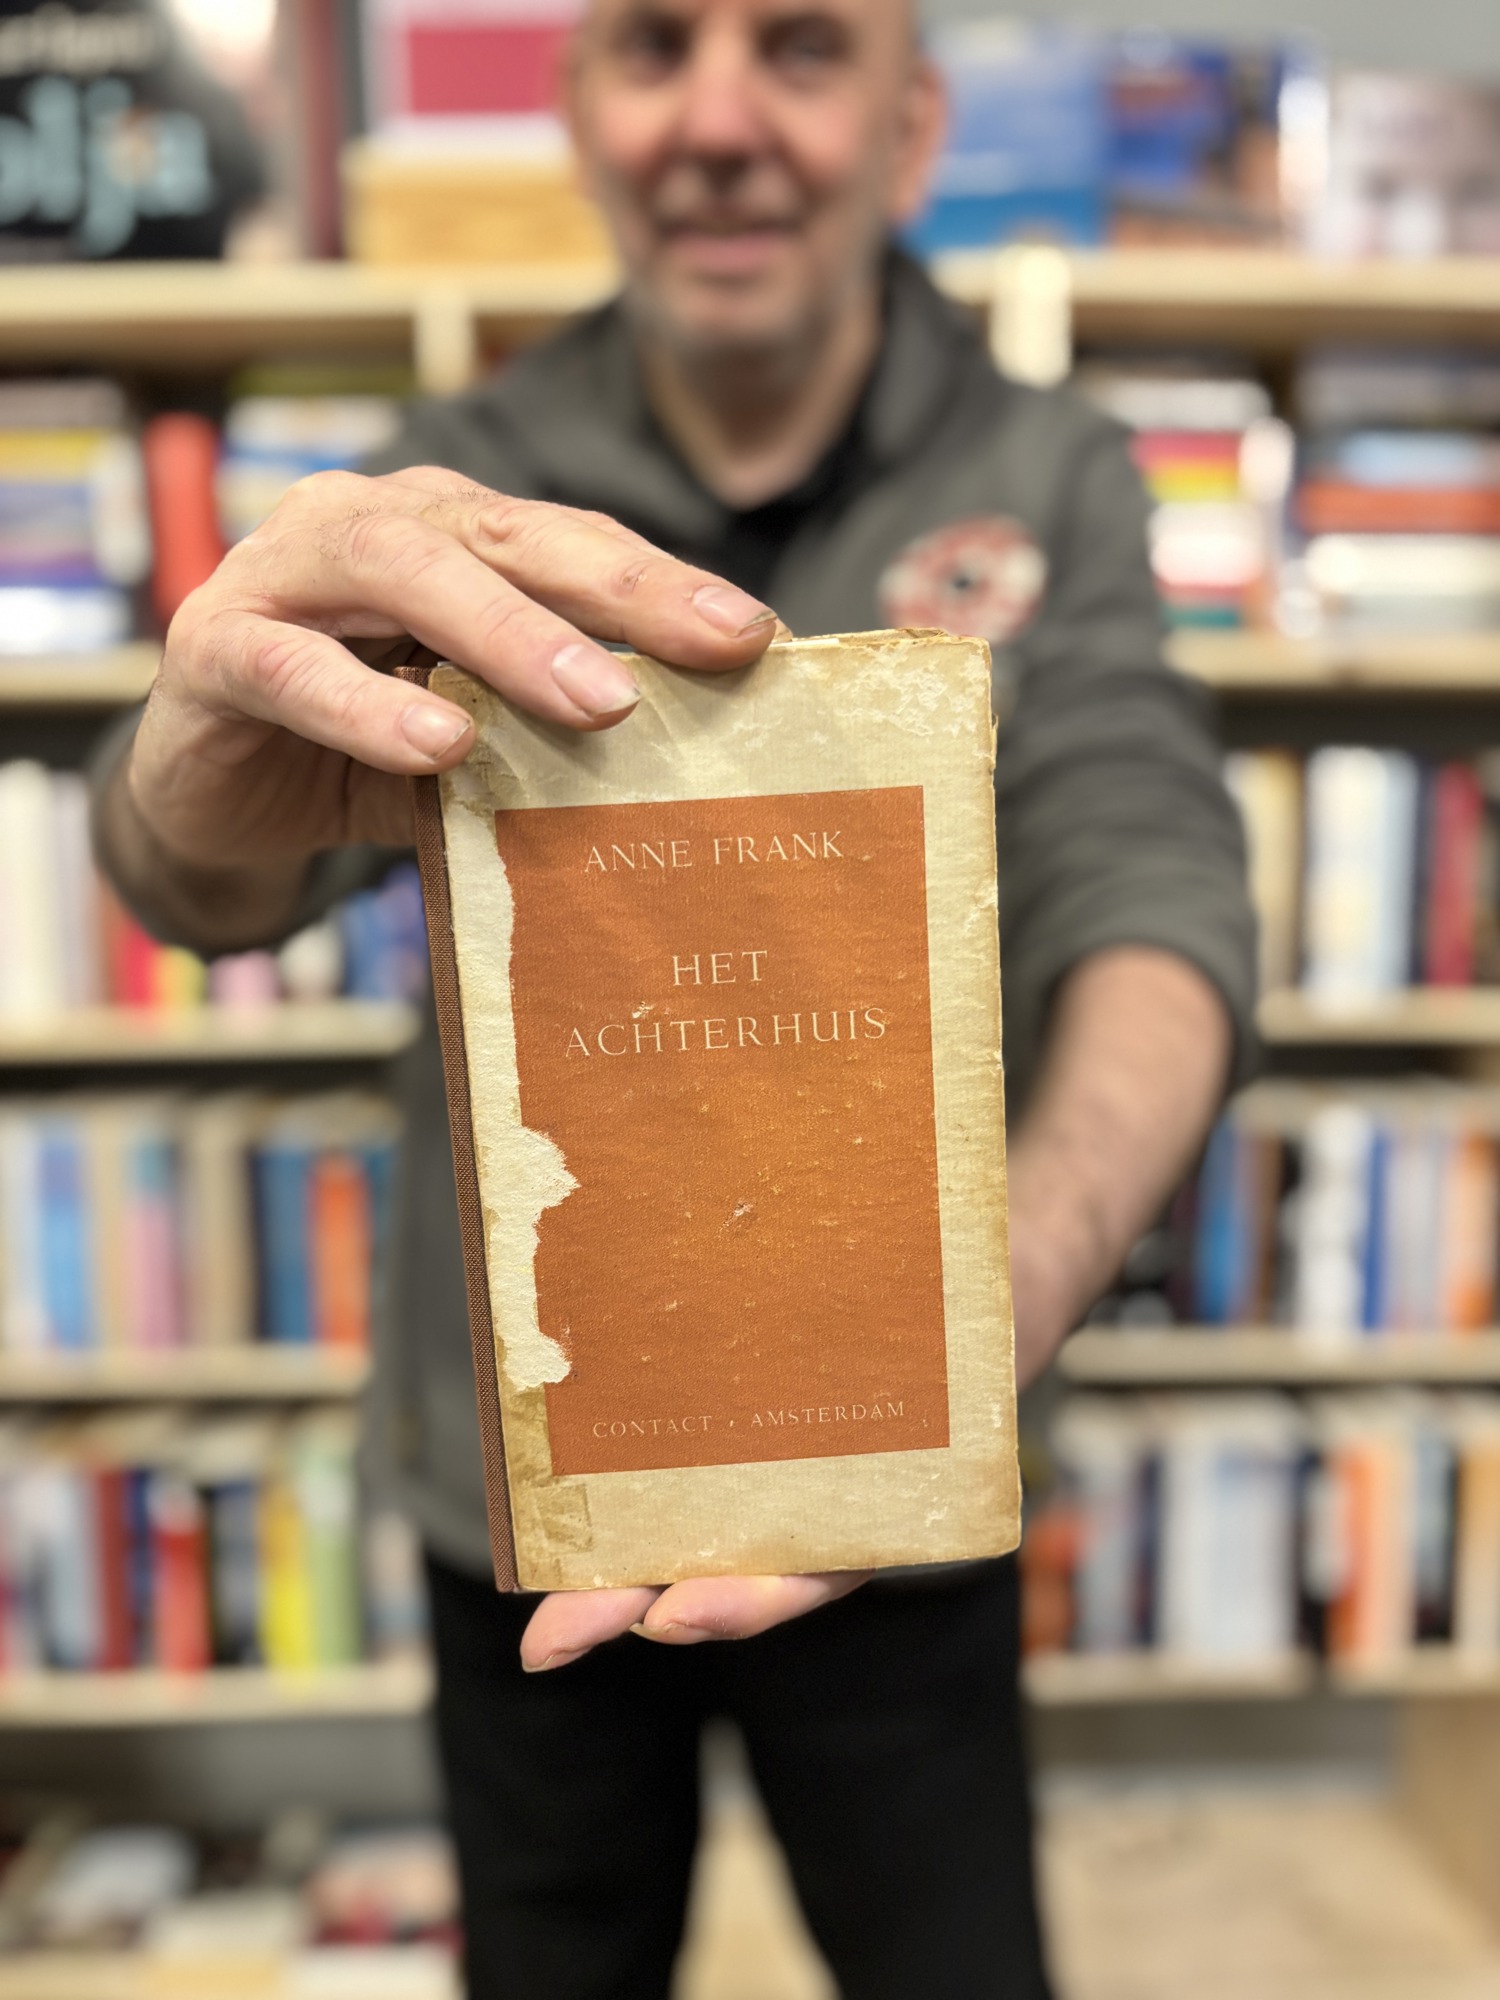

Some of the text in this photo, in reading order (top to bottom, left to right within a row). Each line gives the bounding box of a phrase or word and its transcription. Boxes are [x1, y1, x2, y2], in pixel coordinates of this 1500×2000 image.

[585, 831, 845, 873] ANNE FRANK
[672, 950, 768, 986] HET
[565, 1007, 888, 1058] ACHTERHUIS
[592, 1400, 905, 1439] CONTACT AMSTERDAM
